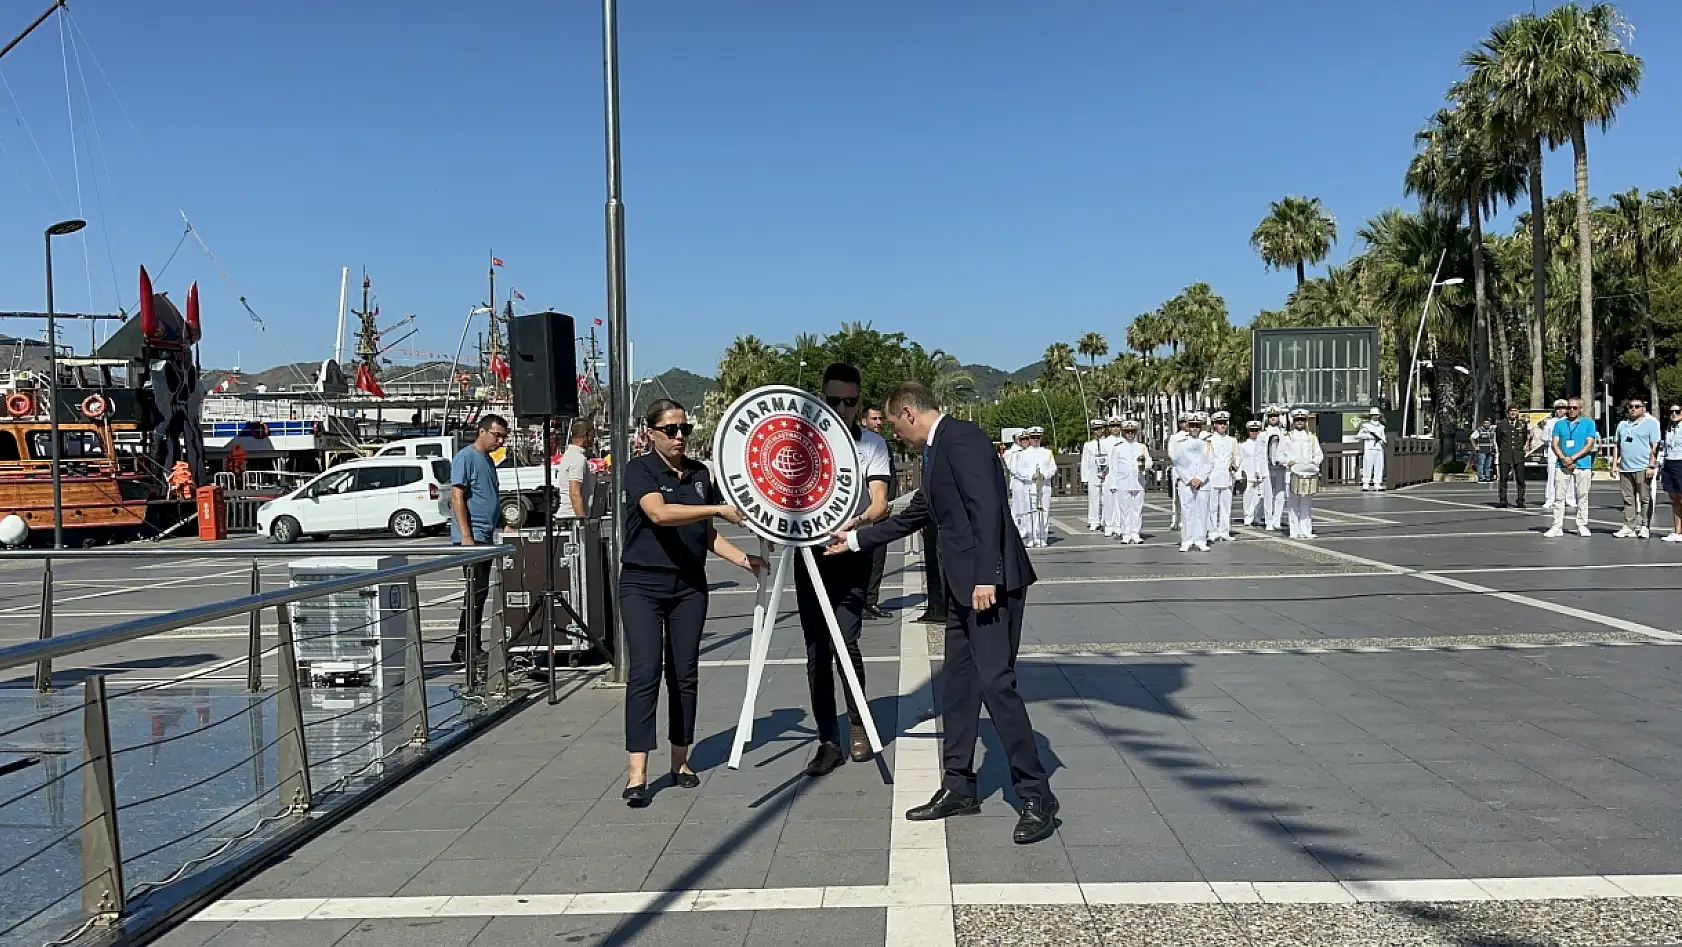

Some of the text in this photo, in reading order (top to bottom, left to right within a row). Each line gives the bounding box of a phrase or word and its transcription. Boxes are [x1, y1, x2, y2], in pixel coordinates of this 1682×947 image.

[734, 397, 832, 436] MARMARİS
[728, 467, 853, 538] LİMAN BAŞKANLIĞI
